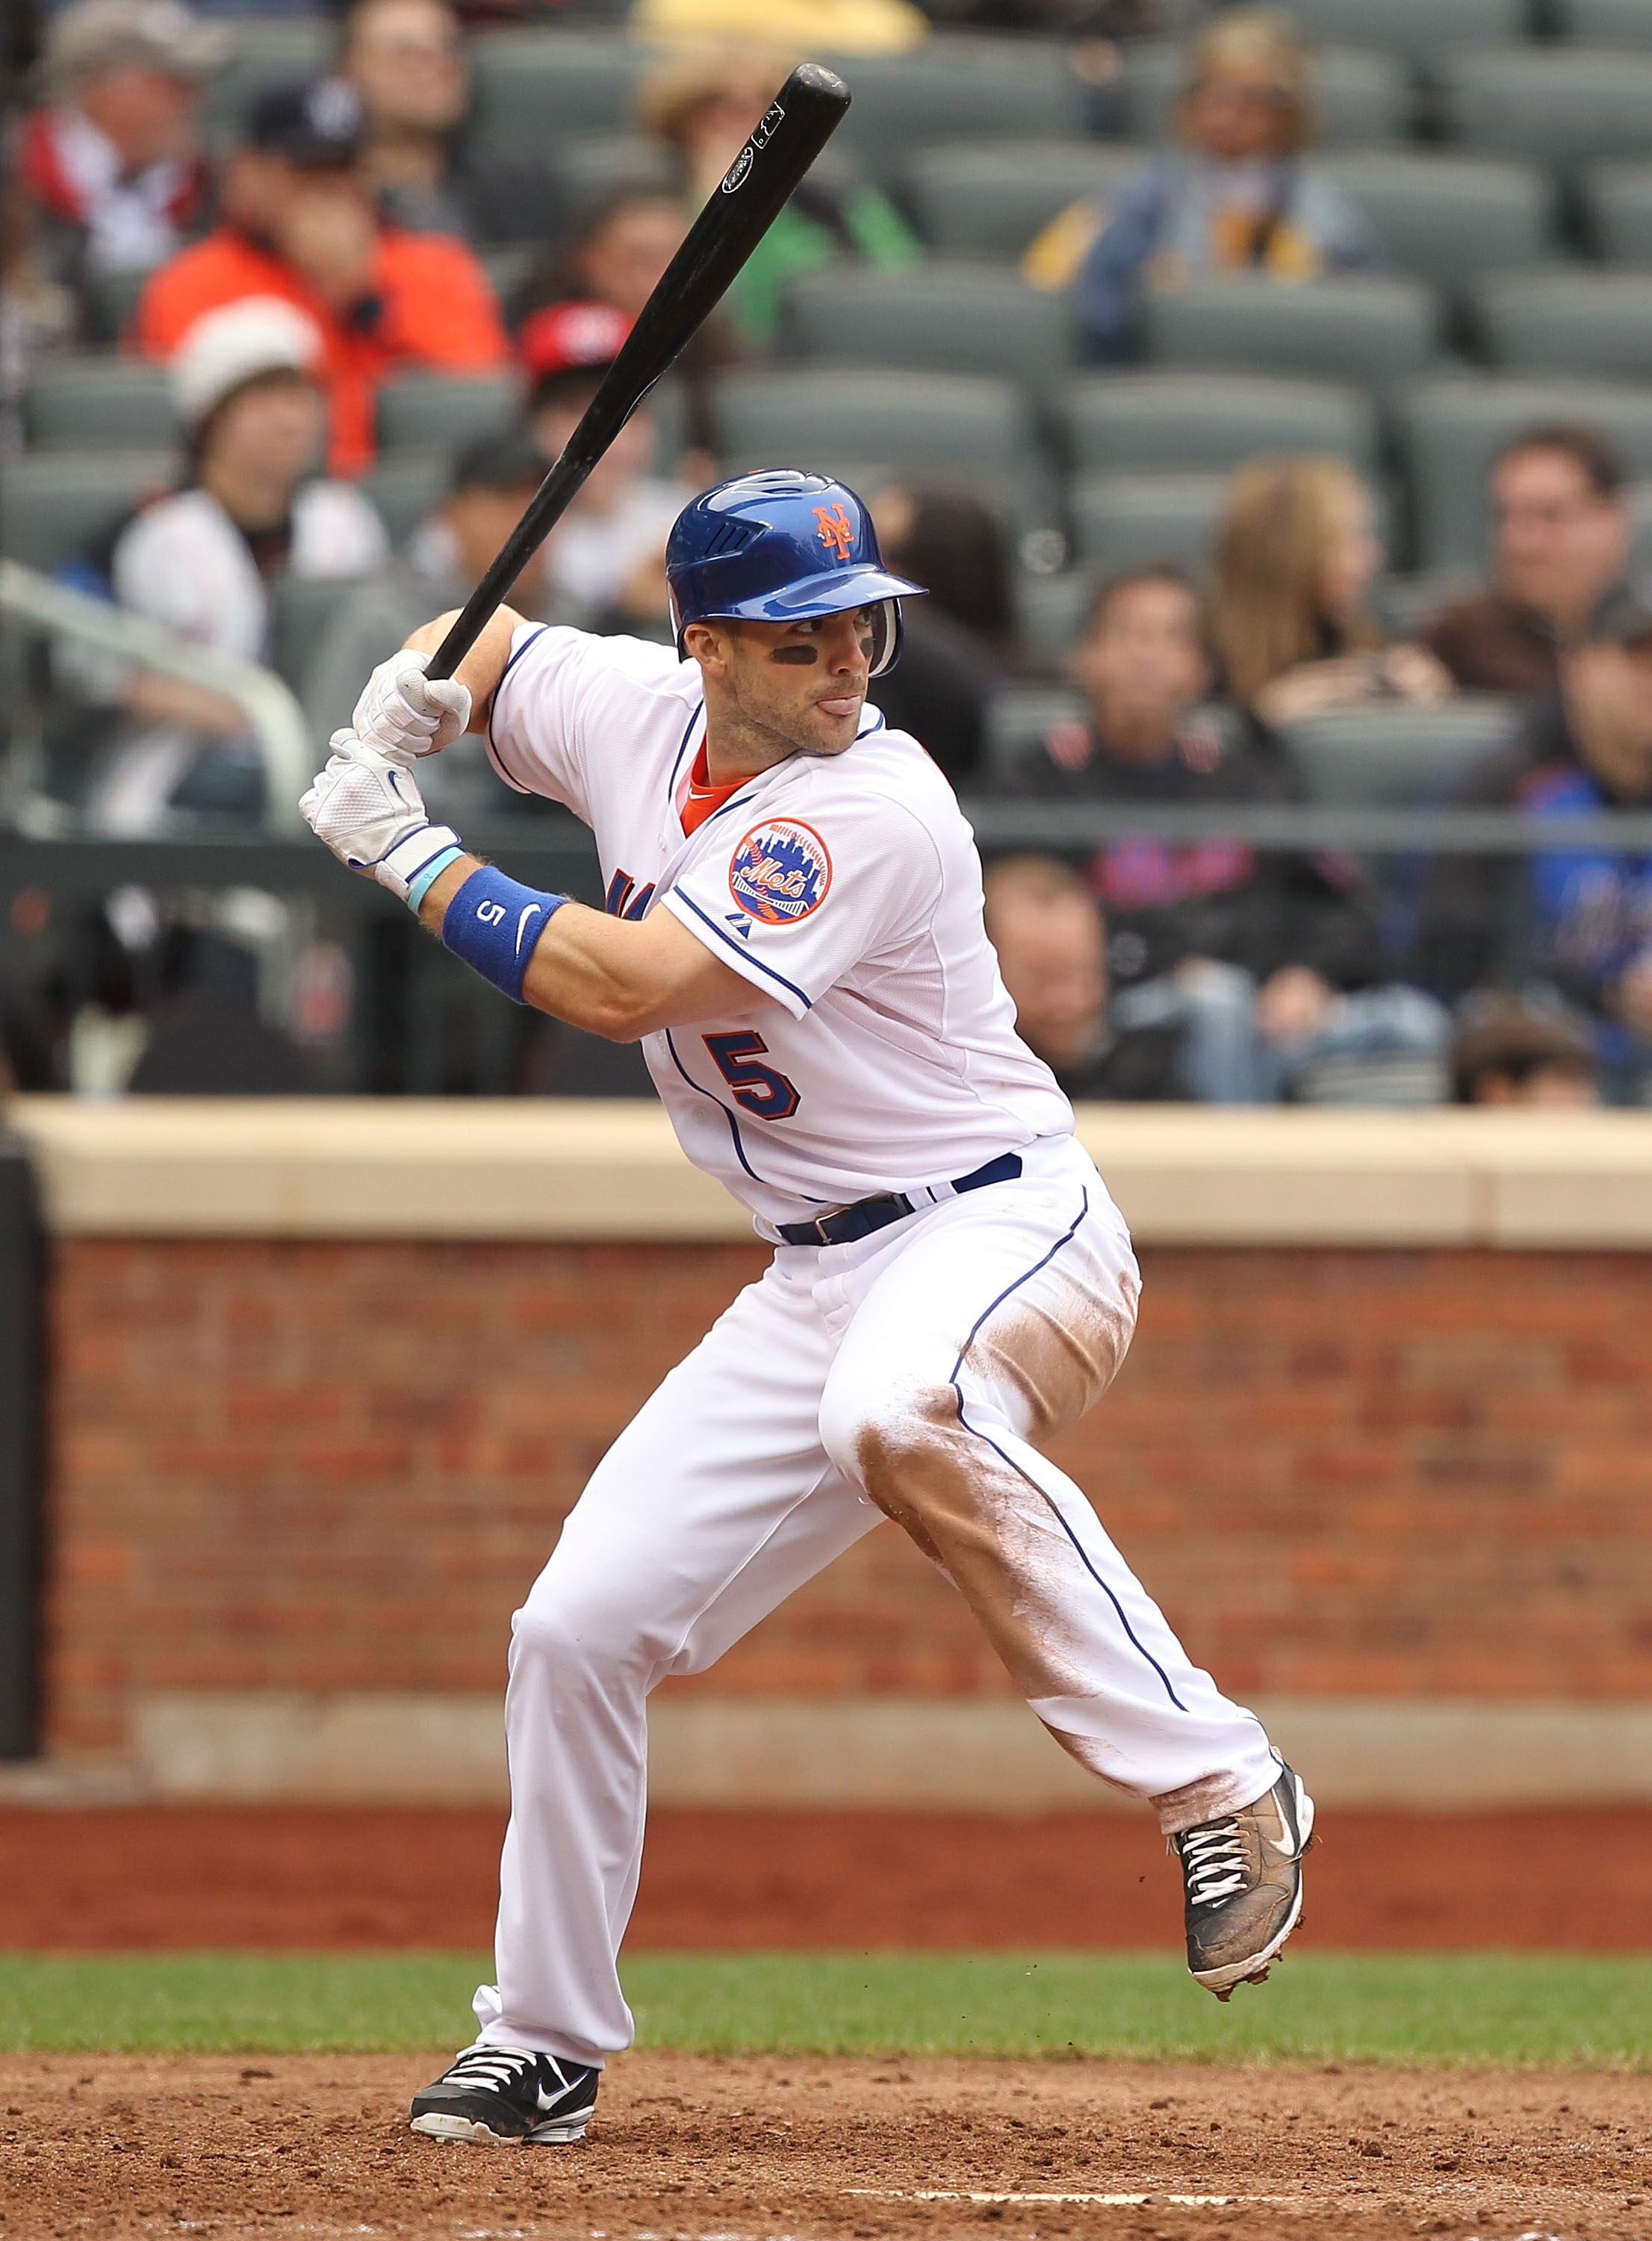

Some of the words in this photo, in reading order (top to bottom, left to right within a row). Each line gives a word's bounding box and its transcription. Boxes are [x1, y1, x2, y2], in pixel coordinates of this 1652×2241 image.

[741, 856, 807, 898] Mets
[476, 900, 507, 926] 5
[701, 1030, 801, 1120] 5
